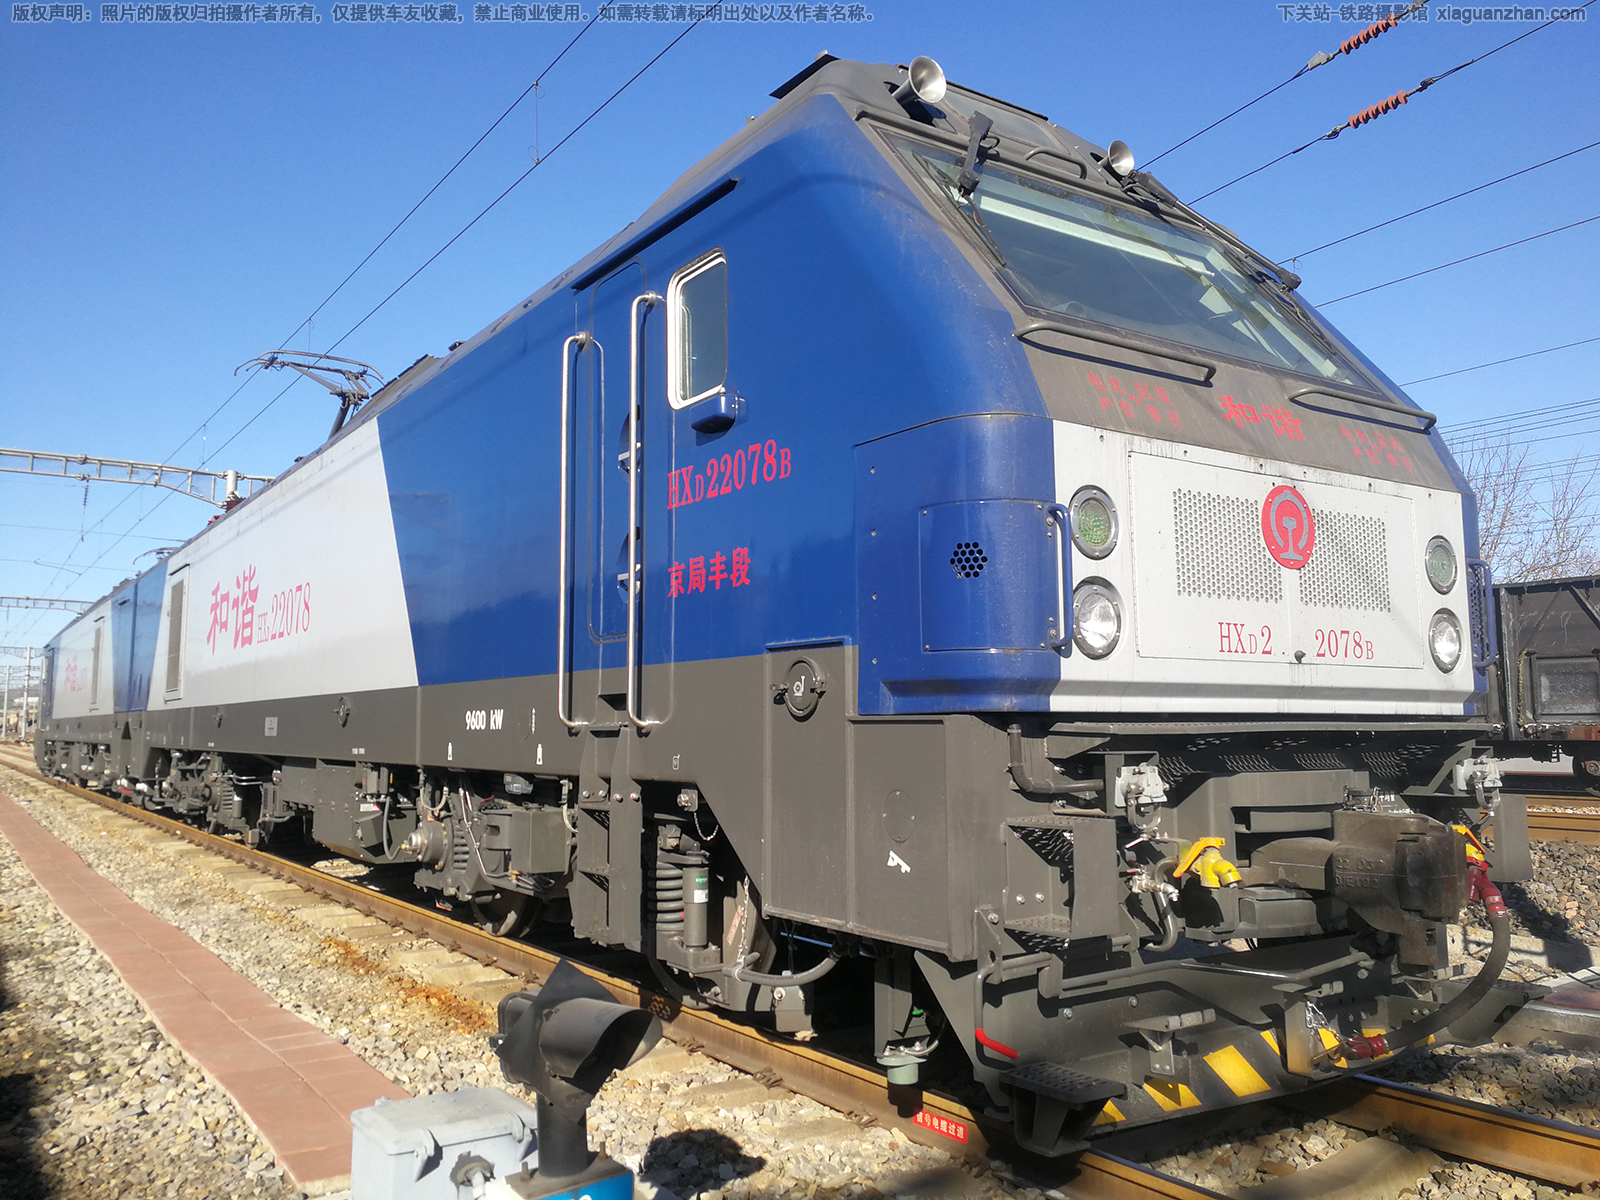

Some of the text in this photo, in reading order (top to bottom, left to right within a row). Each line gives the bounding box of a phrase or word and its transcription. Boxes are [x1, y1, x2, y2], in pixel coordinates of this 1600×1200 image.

[1217, 395, 1305, 441] 和谐
[667, 547, 751, 599] 京局丰段
[206, 564, 260, 656] 和谐
[1315, 629, 1374, 660] 2078B
[465, 708, 504, 731] 9600 kW
